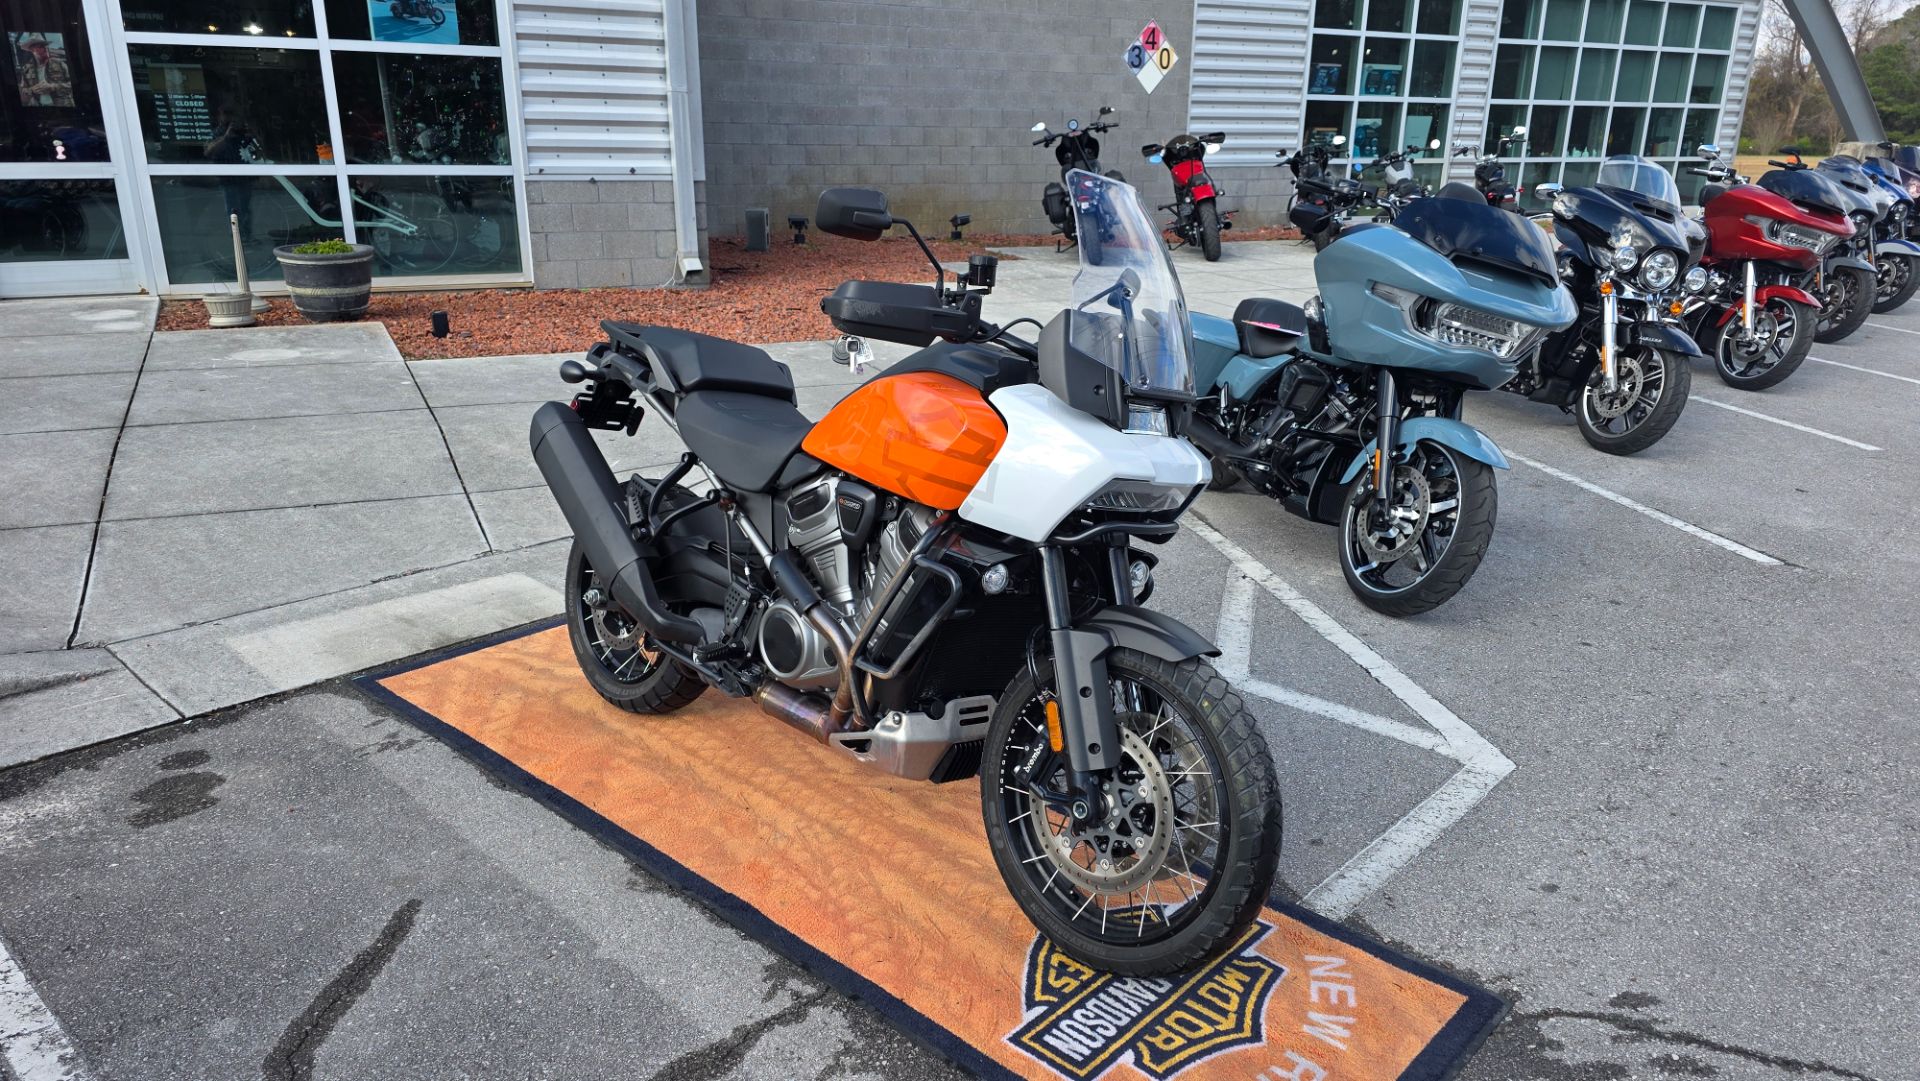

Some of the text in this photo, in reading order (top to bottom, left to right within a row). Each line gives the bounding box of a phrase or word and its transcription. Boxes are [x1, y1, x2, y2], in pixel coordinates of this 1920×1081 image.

[1145, 27, 1157, 50] 4
[1131, 45, 1142, 69] 3
[1023, 743, 1044, 773] brembo
[1143, 966, 1251, 1051] MOTOR
[1303, 954, 1358, 1051] NEW
